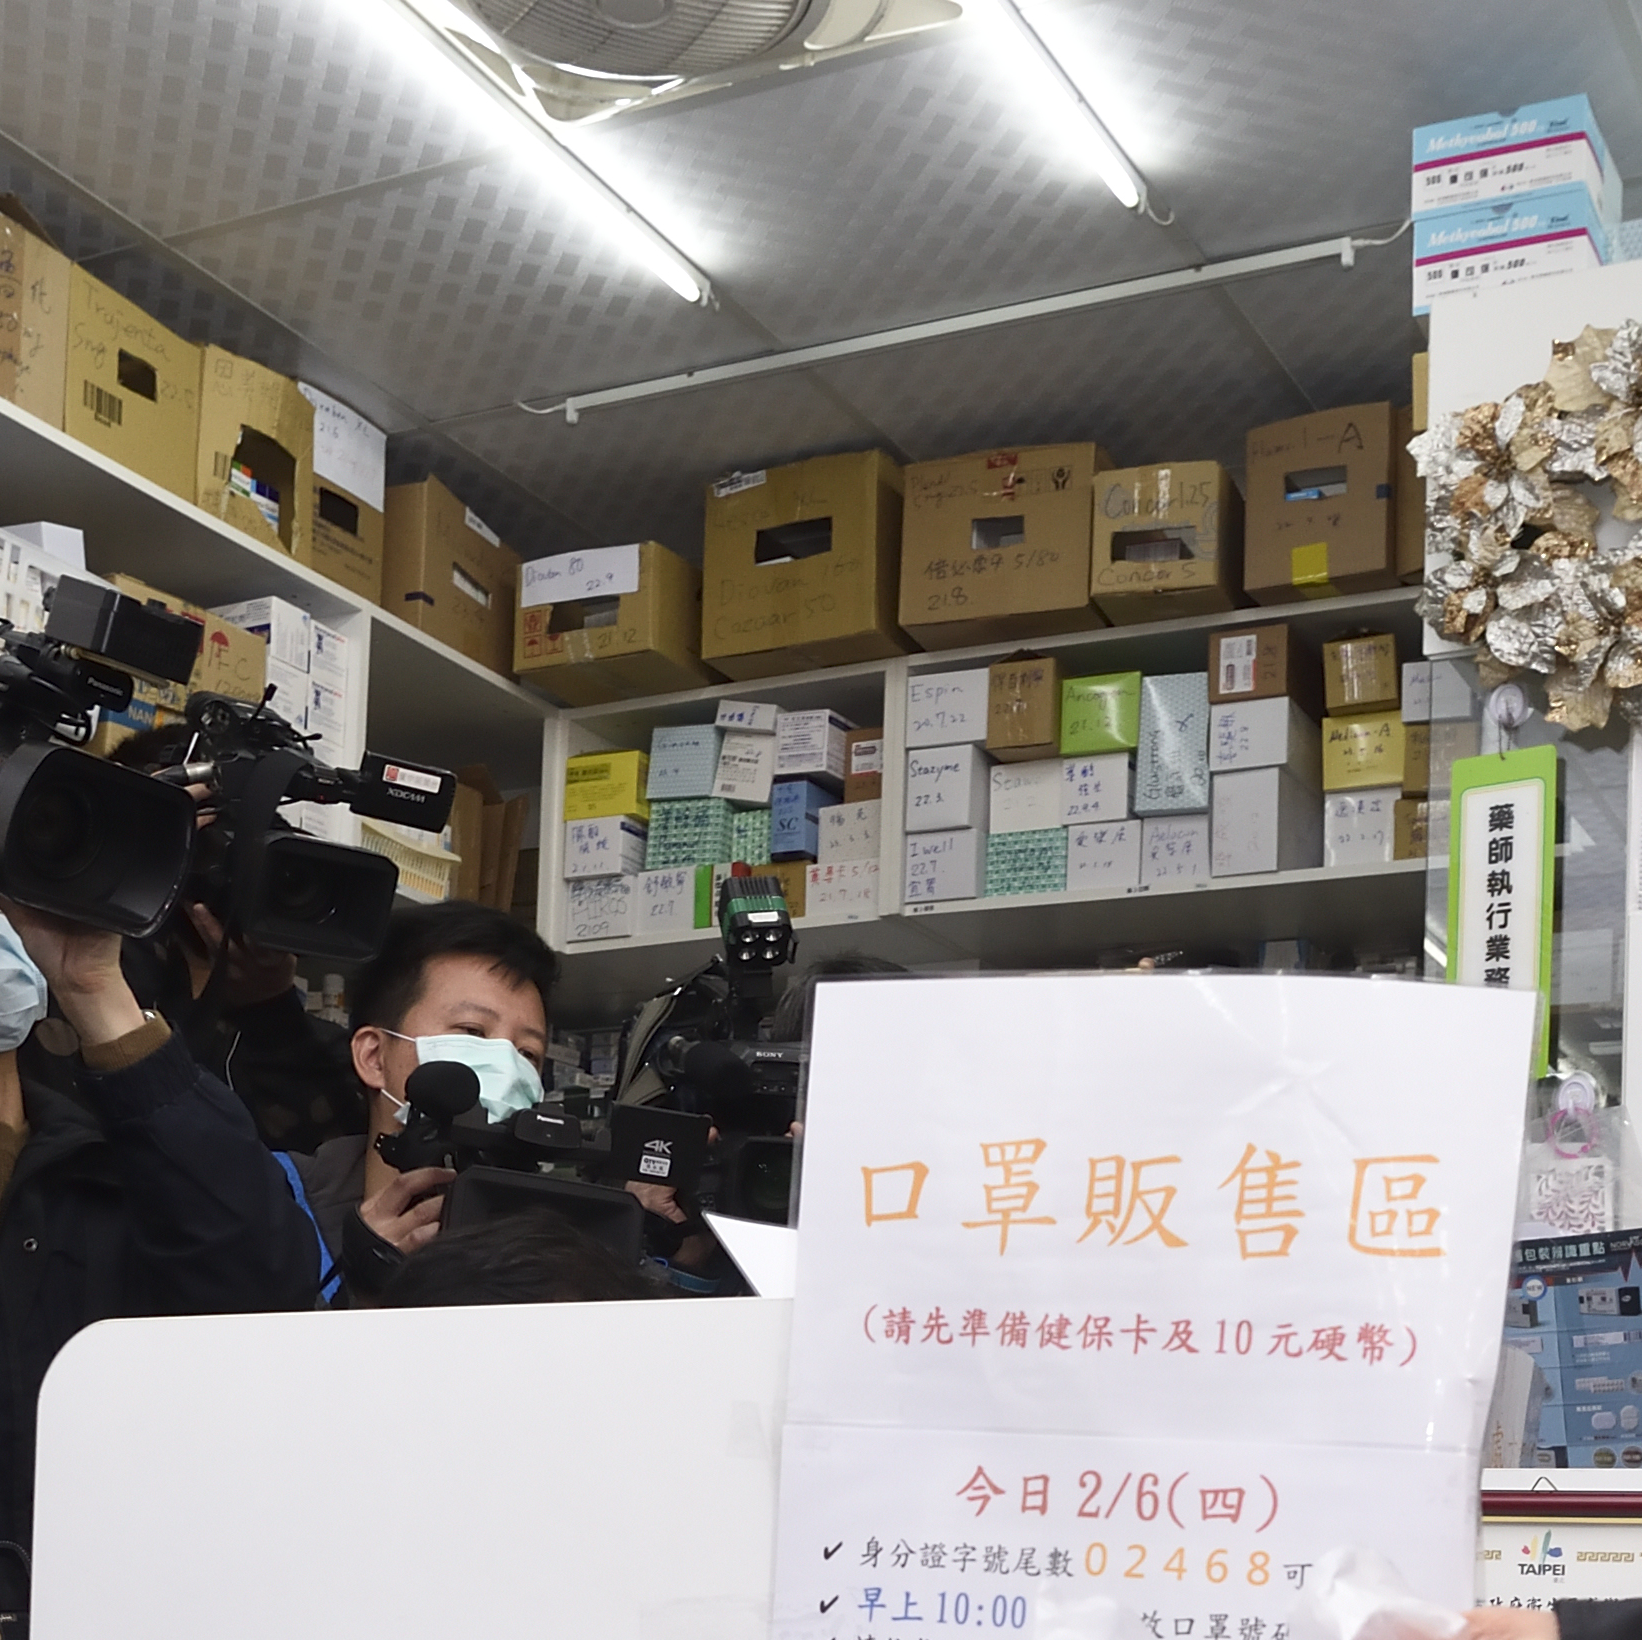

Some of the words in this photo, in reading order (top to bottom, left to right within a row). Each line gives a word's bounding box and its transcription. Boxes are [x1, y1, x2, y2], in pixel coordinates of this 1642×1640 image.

[1509, 119, 1538, 138] 500
[1510, 214, 1539, 232] 500
[386, 787, 426, 804] XDCAM
[776, 816, 800, 832] SC
[643, 1139, 673, 1155] 4K
[859, 1137, 1448, 1261] 口罩販售區
[1518, 1563, 1566, 1576] TAIPEI
